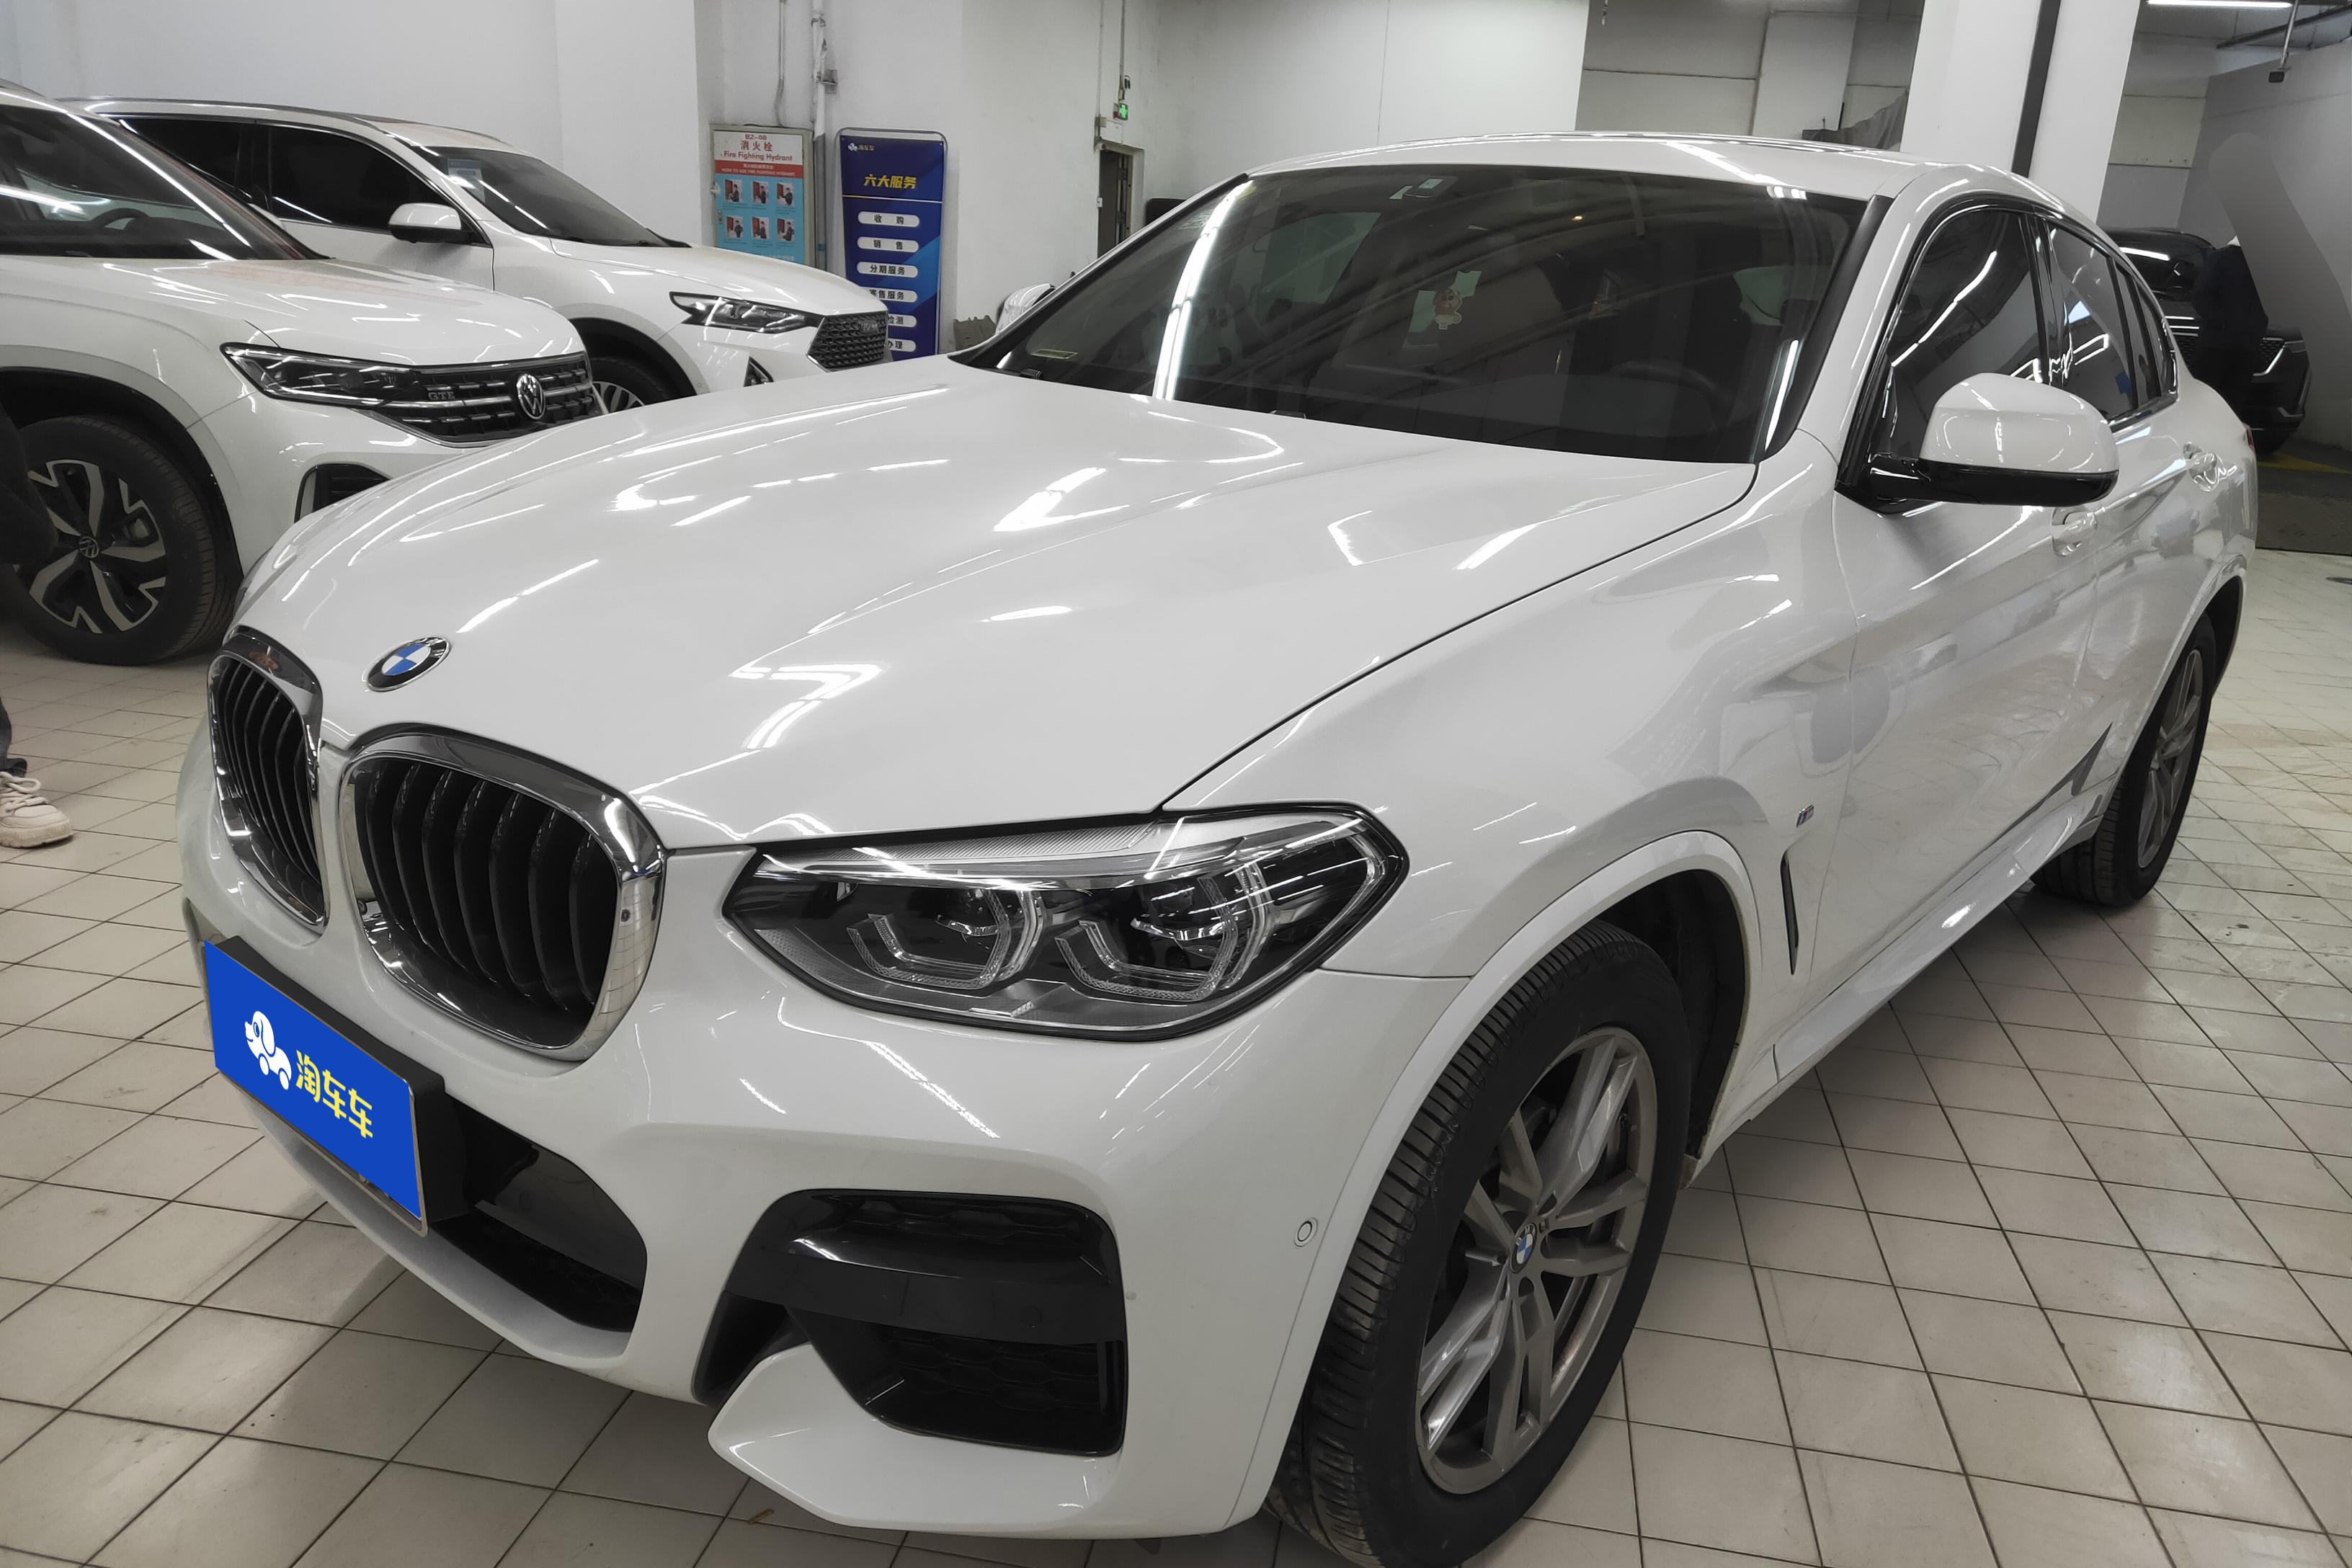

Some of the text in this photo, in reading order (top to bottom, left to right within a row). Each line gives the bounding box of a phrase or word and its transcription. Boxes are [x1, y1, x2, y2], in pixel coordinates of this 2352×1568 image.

[740, 140, 773, 151] 消火栓
[738, 151, 764, 161] Fighting
[863, 174, 917, 189] 六大服务
[870, 264, 905, 275] 分期服务
[427, 391, 455, 401] GTE
